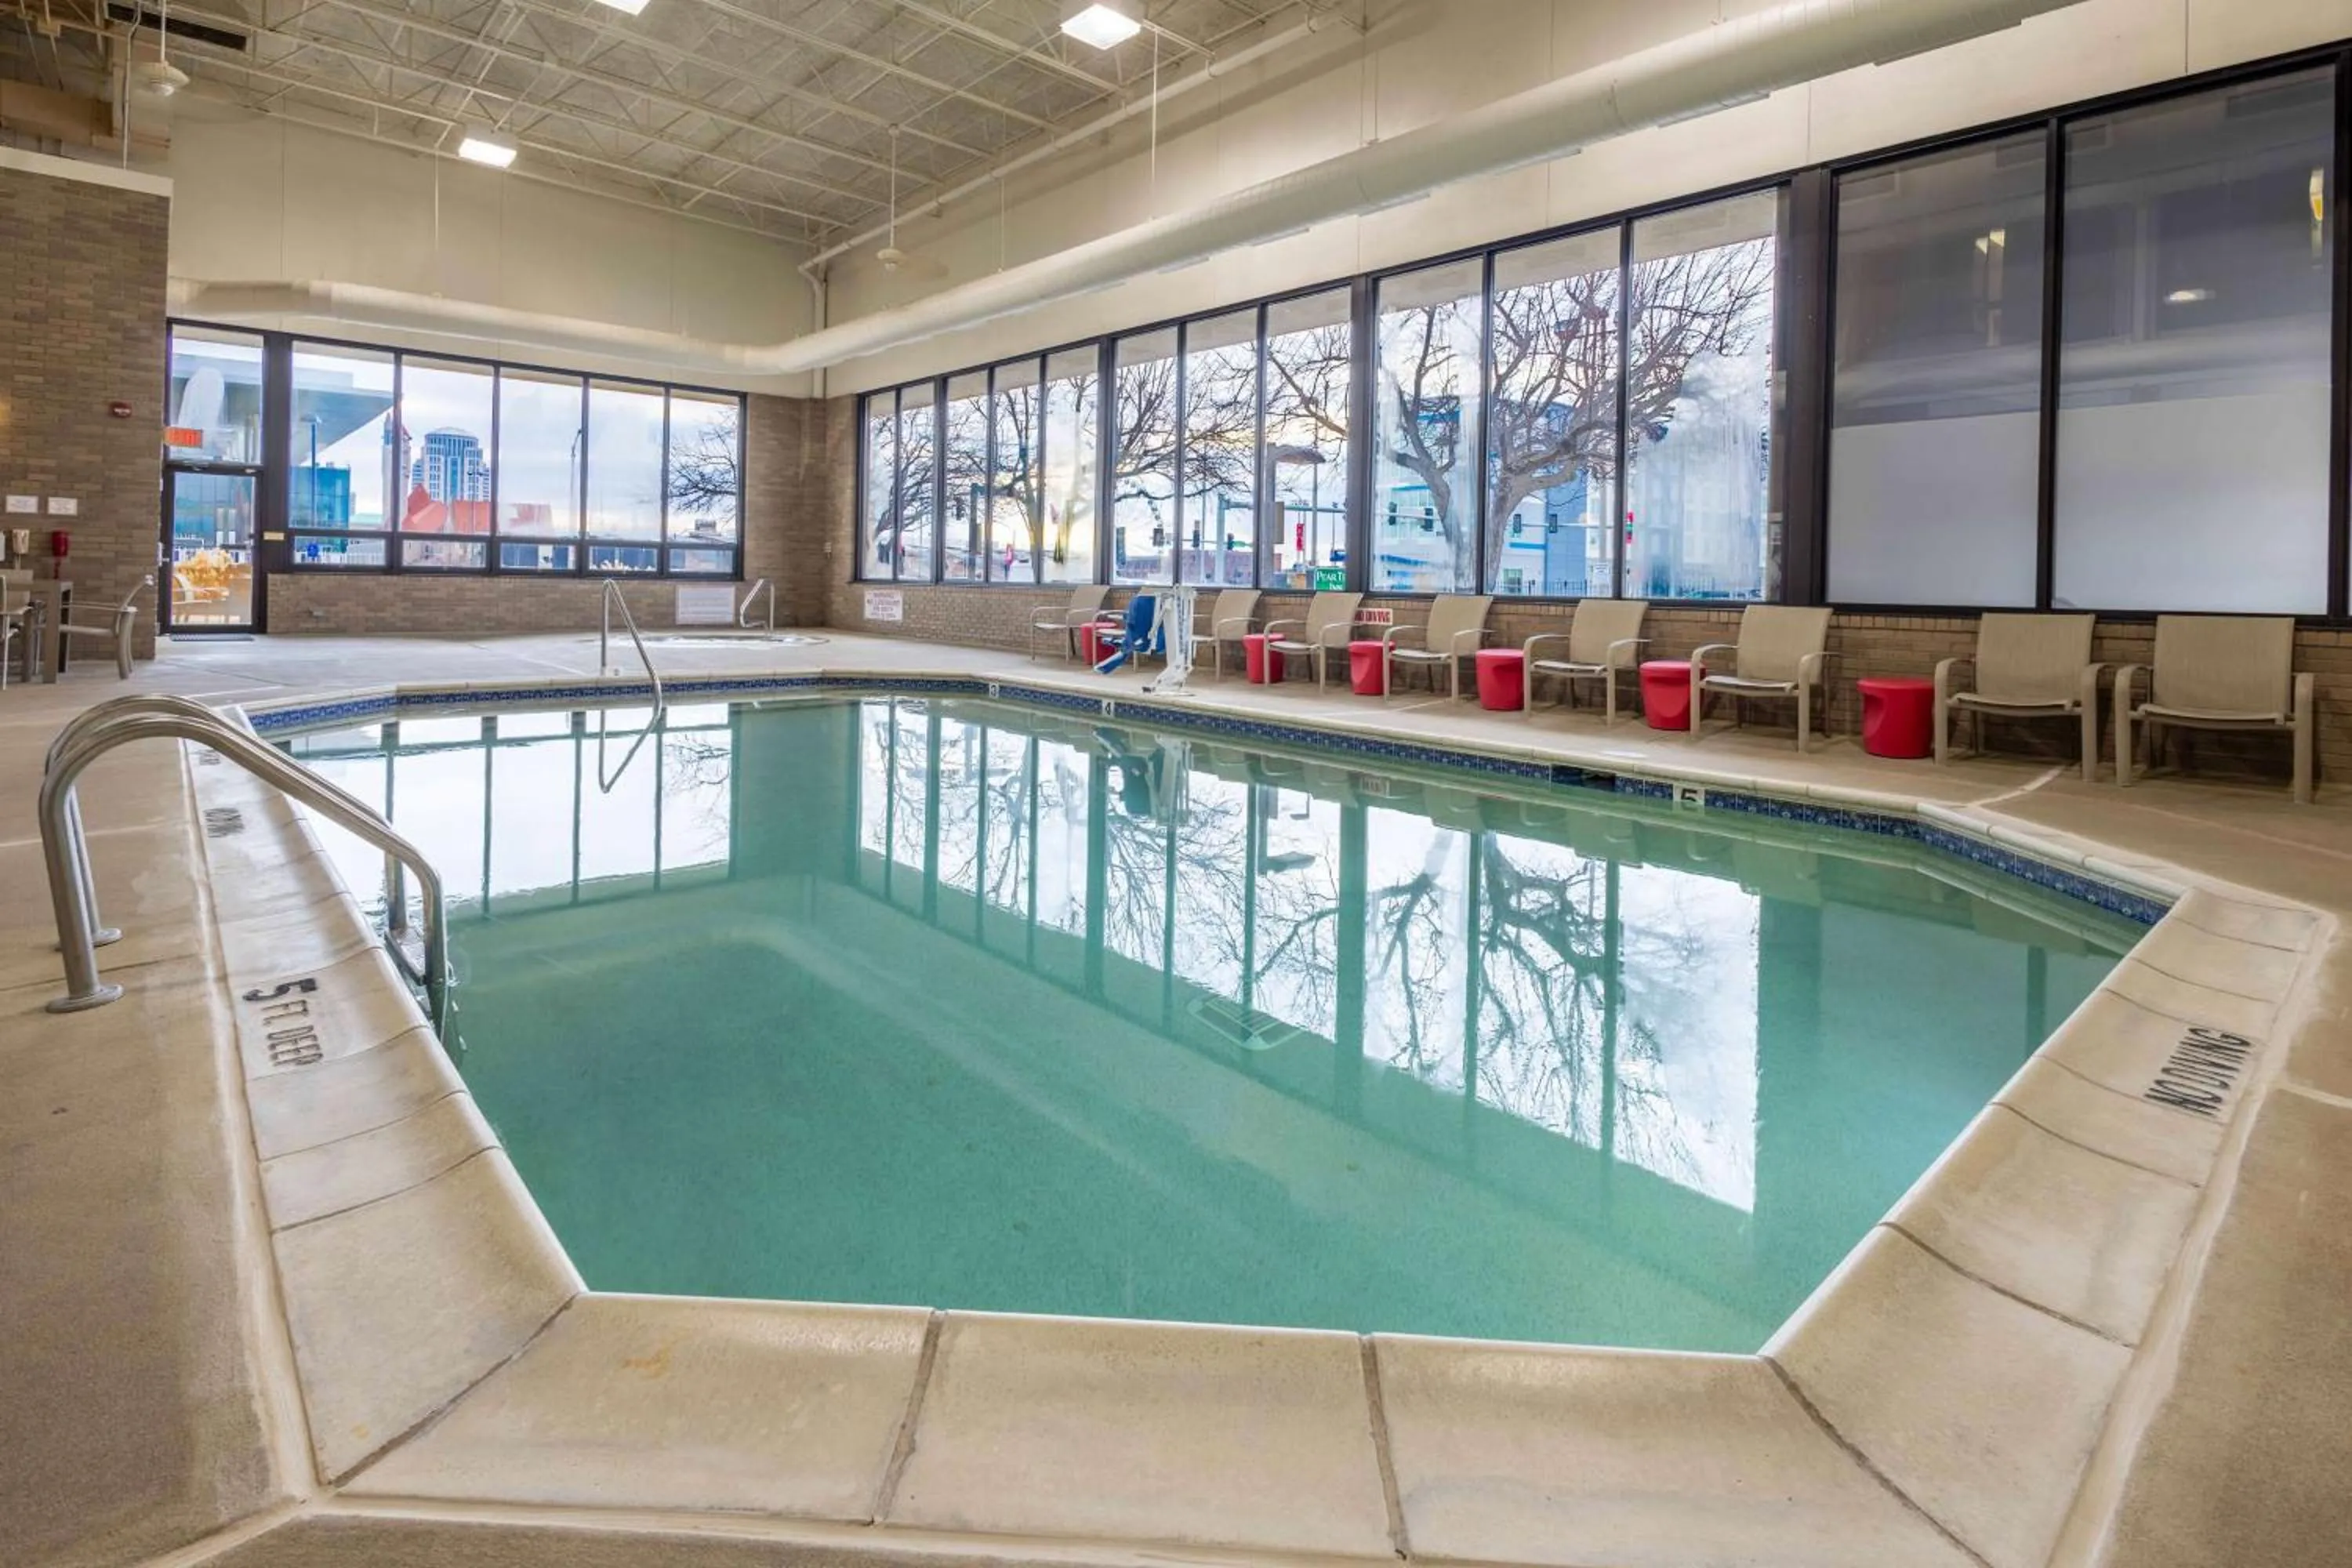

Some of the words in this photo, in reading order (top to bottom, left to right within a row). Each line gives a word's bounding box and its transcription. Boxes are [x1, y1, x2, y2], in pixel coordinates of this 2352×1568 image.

[1366, 611, 1390, 622] DIVING
[990, 684, 996, 696] 3
[1105, 702, 1111, 715] 4
[242, 977, 318, 1002] 5
[267, 1025, 324, 1067] DEEP
[2161, 1027, 2252, 1091] DIVING
[2143, 1079, 2223, 1117] NO
